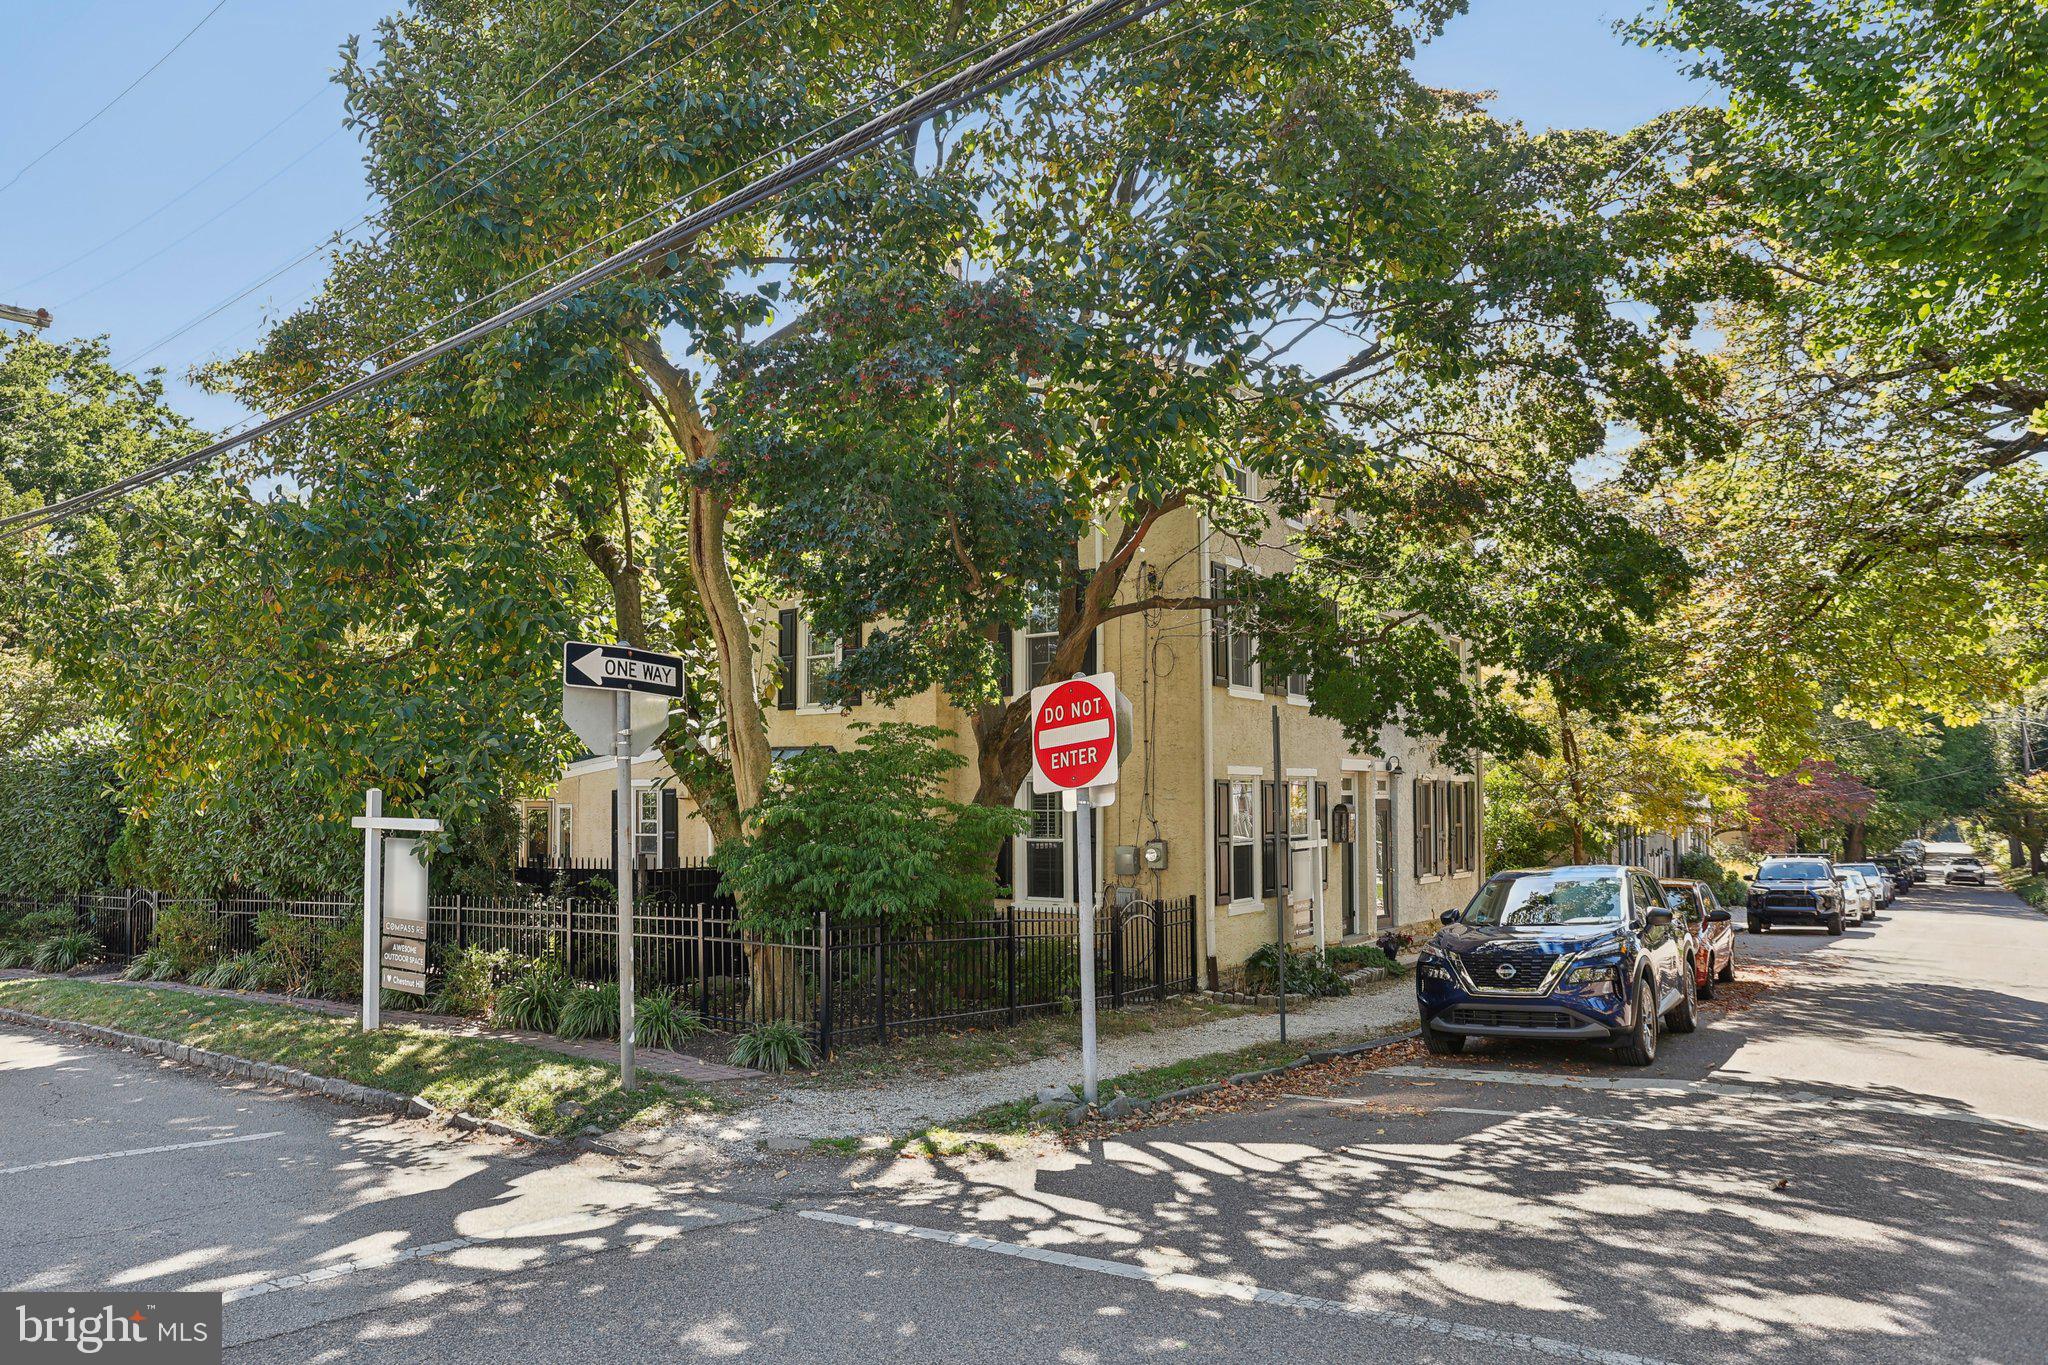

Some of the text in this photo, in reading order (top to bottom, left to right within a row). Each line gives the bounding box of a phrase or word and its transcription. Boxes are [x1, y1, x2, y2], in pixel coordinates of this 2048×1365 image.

[604, 659, 672, 683] ONE WAY
[1044, 697, 1102, 724] DO NOT
[1051, 746, 1098, 770] ENTER
[385, 921, 415, 933] COMPASS
[392, 943, 417, 954] AWESOME
[383, 952, 424, 966] OUTDOOR SPACE
[392, 975, 415, 988] Chestnut
